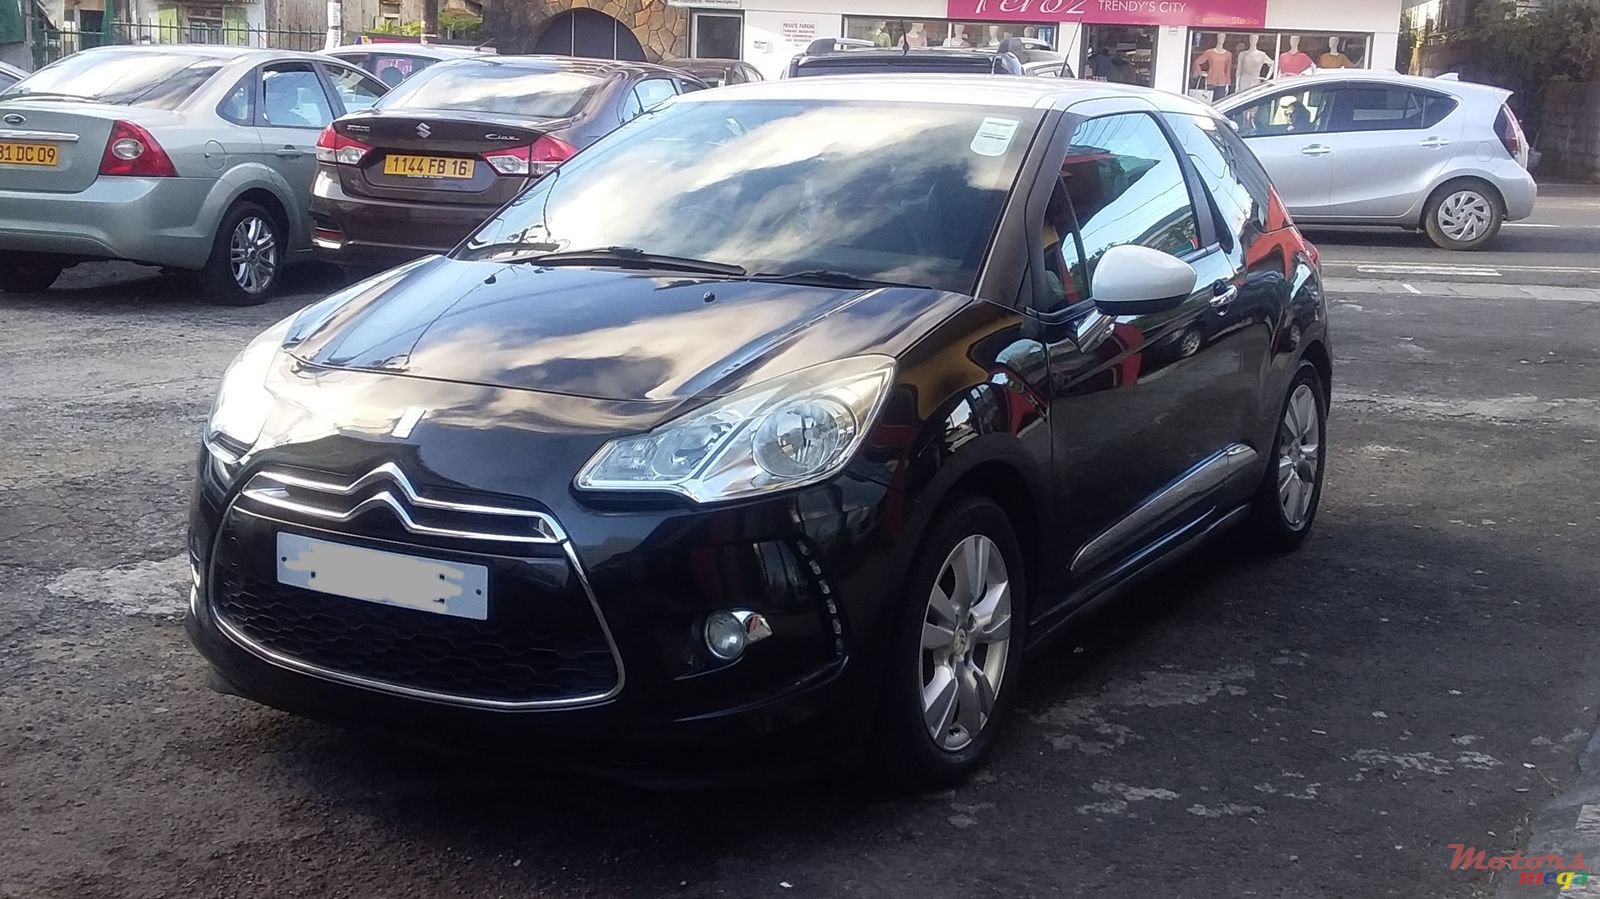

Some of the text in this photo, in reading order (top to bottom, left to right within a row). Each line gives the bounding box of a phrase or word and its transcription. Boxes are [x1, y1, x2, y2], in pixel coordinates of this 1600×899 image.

[1099, 0, 1187, 13] TRENDY'S CITY
[16, 145, 34, 161] DC
[38, 147, 56, 163] 09
[393, 157, 468, 176] 1144 FB 16
